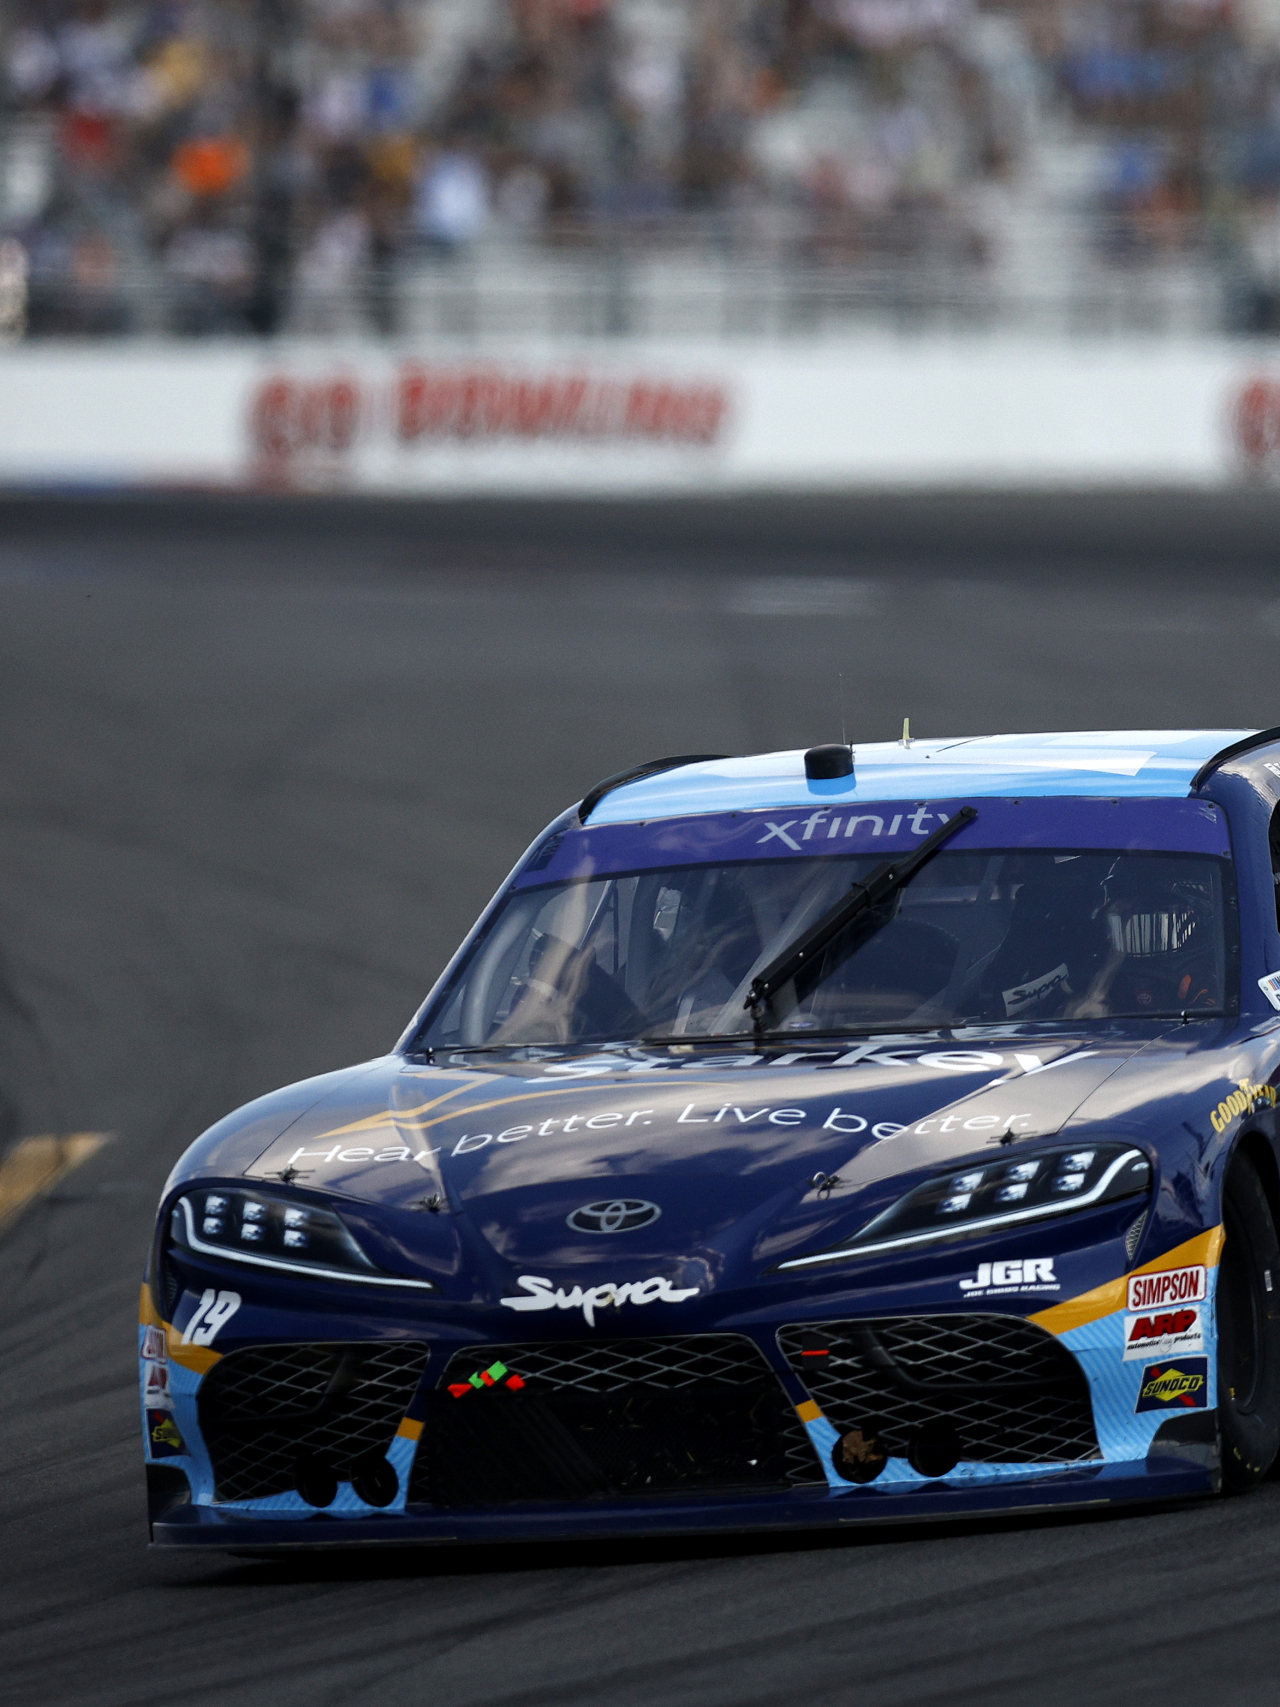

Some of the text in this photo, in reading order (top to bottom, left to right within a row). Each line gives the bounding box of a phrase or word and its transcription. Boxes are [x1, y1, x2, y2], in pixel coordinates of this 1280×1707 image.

[286, 1102, 1032, 1165] Hear better. Live better.
[959, 1258, 1057, 1290] JGR
[1132, 1269, 1200, 1308] SIMPSON
[181, 1288, 242, 1346] 19
[500, 1275, 700, 1327] Supra
[1129, 1309, 1198, 1342] ARP
[1143, 1376, 1201, 1397] SUNOCO
